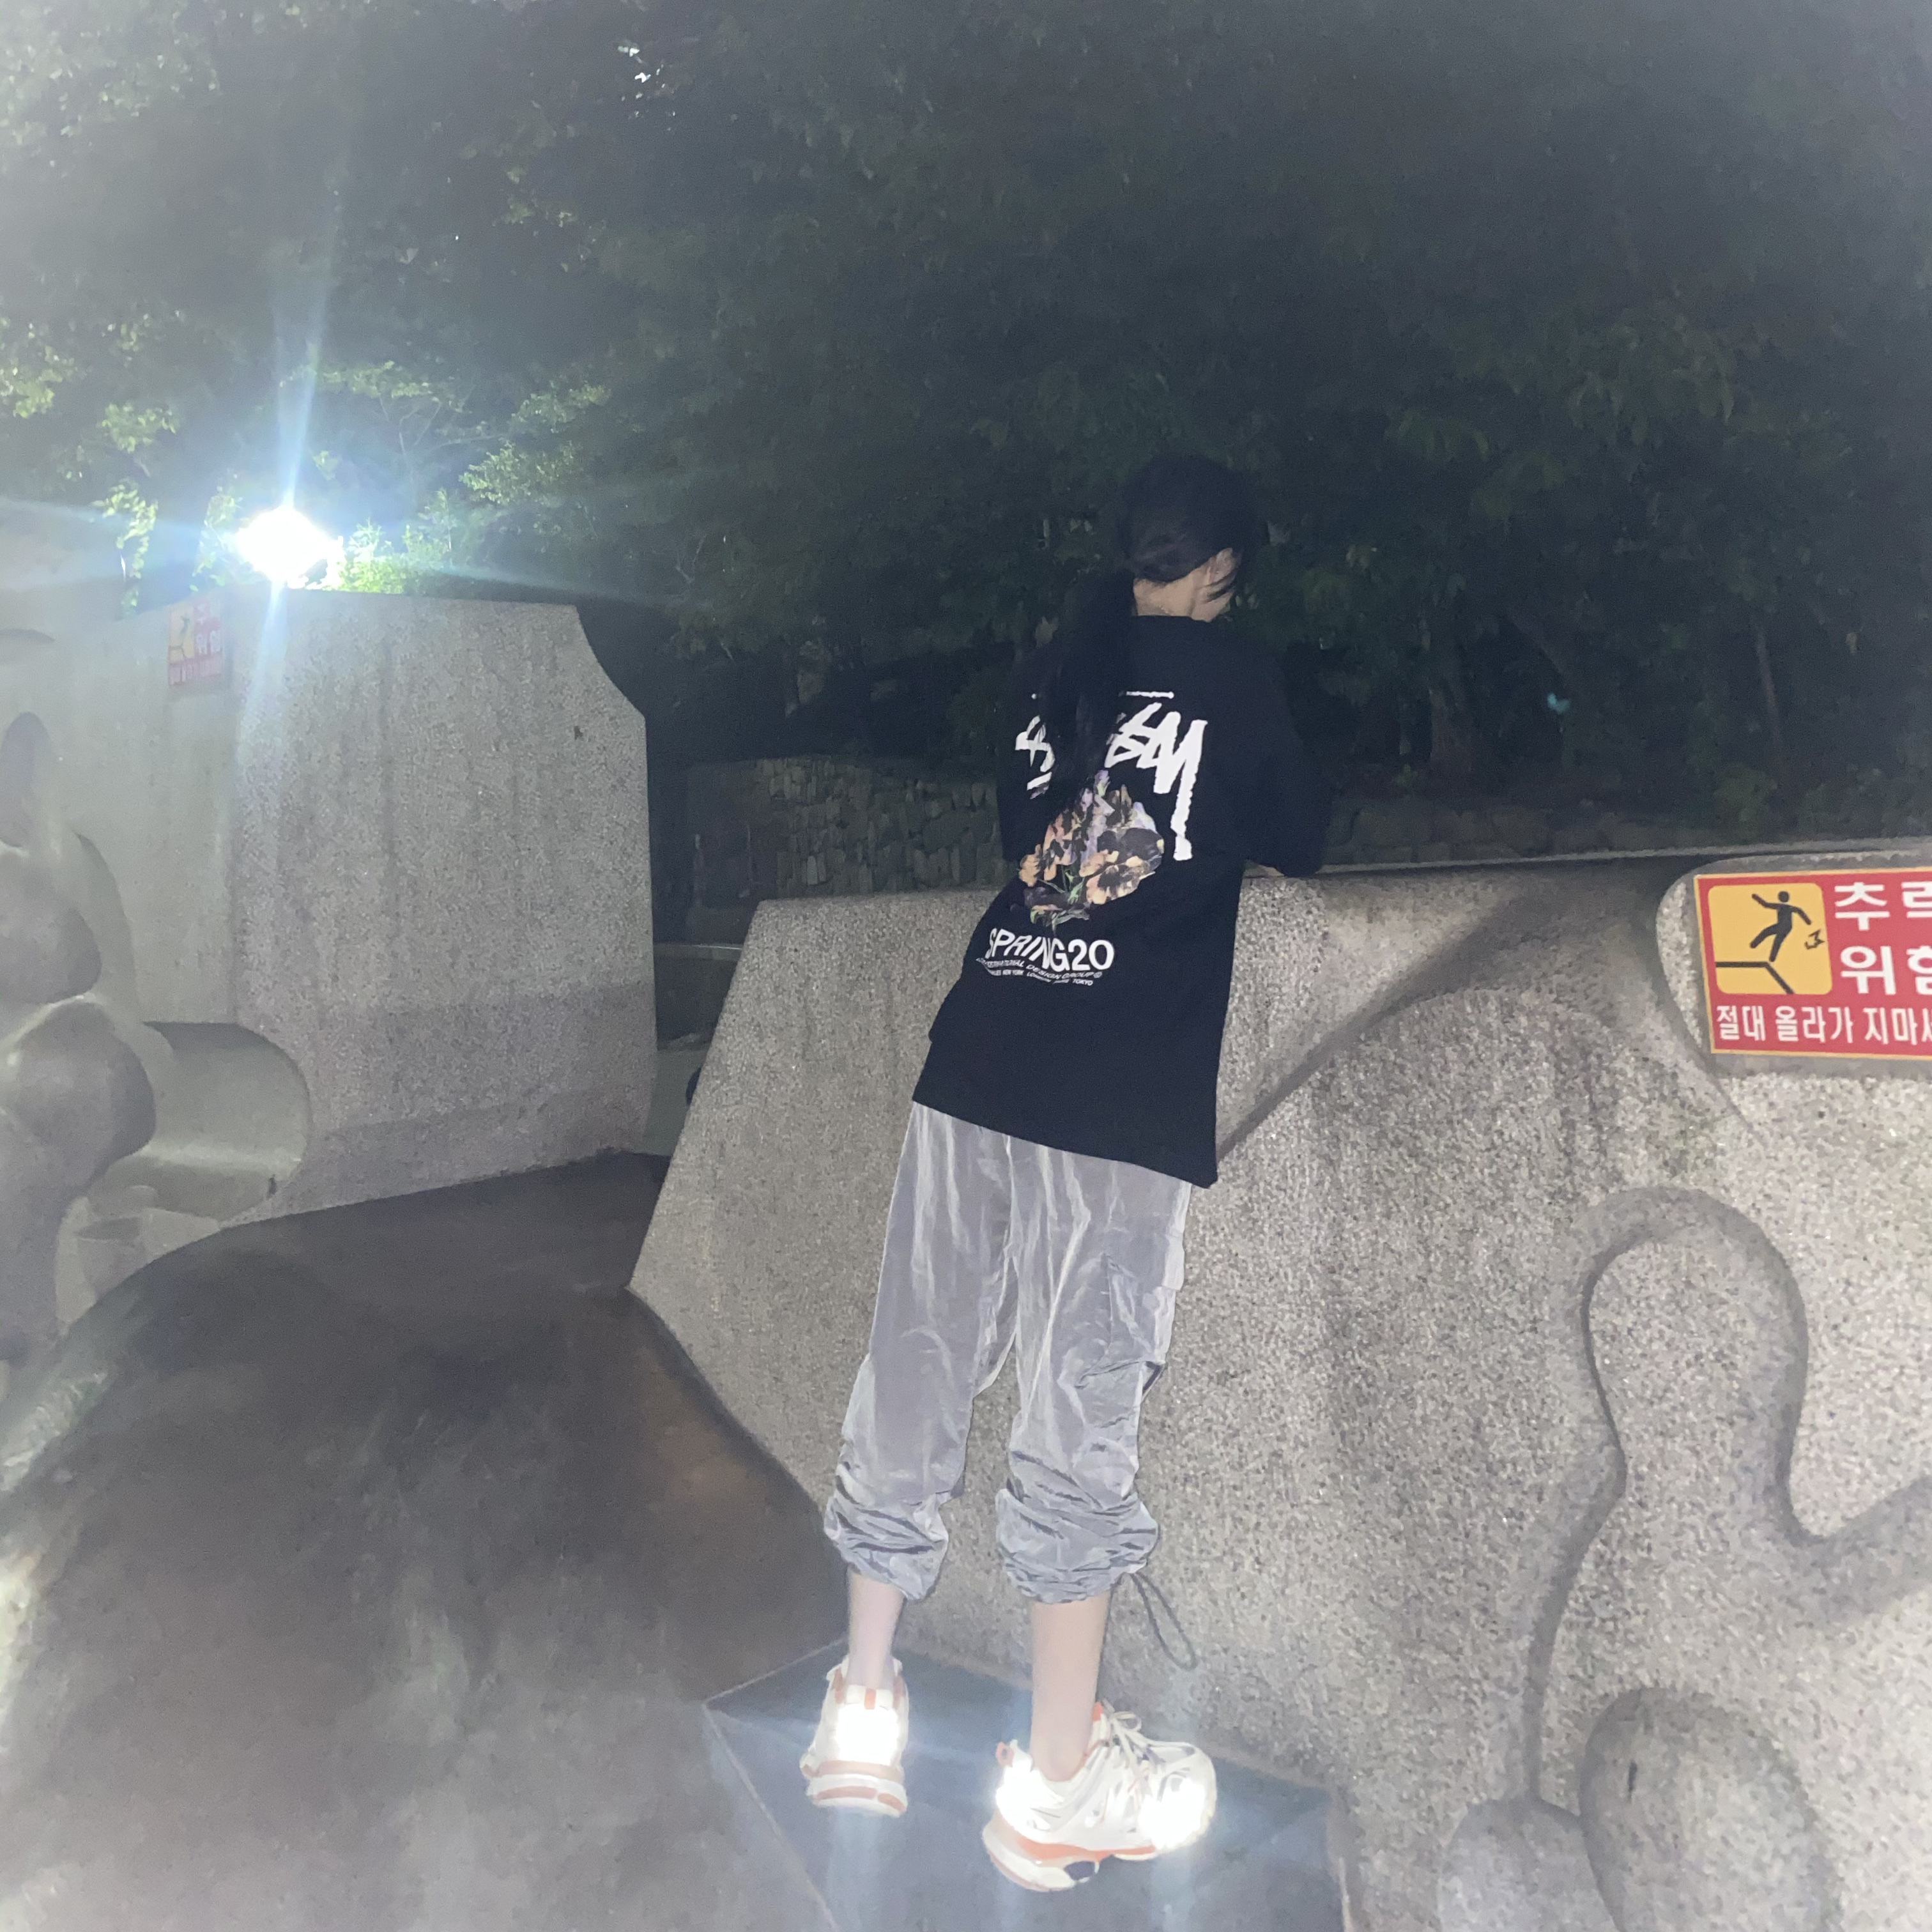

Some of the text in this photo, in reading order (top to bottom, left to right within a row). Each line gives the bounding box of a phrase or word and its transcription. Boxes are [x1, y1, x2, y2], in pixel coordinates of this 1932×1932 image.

[985, 928, 1114, 972] SPRING20
[1716, 1005, 1766, 1041] 절대
[1775, 1005, 1853, 1044] 올라가
